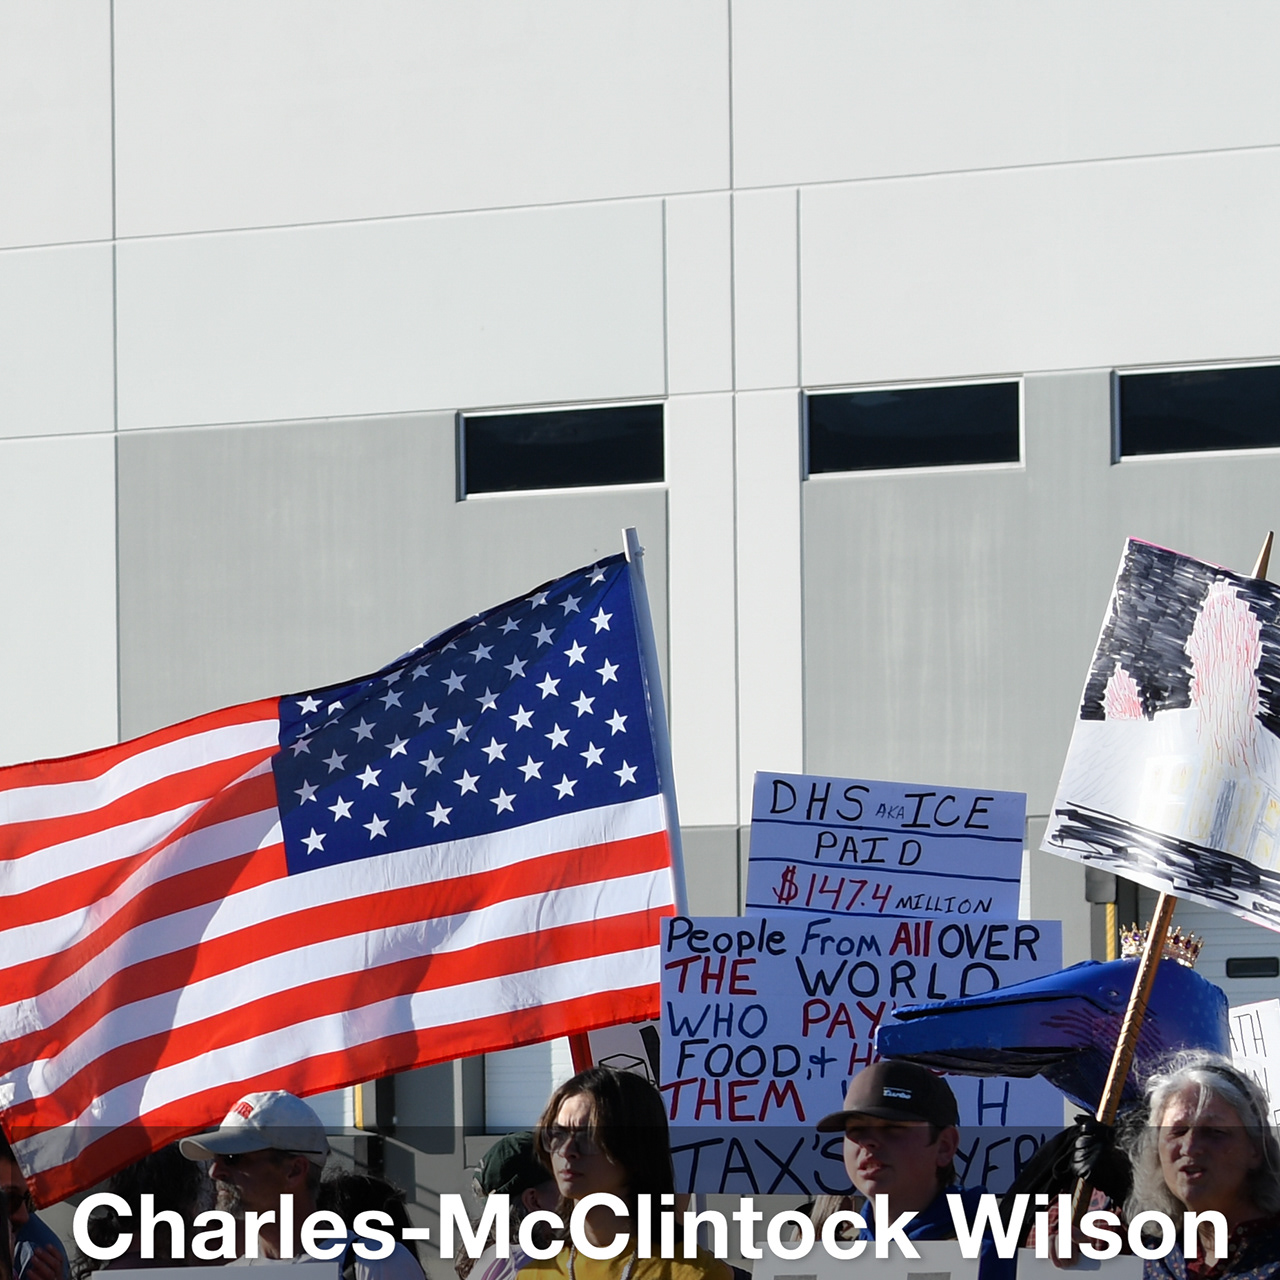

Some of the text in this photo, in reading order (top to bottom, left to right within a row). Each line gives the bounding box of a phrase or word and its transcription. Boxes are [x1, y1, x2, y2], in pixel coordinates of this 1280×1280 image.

[770, 780, 994, 829] DHS AKA ICE
[814, 831, 922, 866] PAID
[772, 864, 993, 915] $147.4 MILLION
[667, 916, 1041, 961] People From All OVER
[665, 955, 1000, 999] THE WORLD
[666, 1000, 768, 1039] WHO
[660, 1077, 806, 1122] THEM
